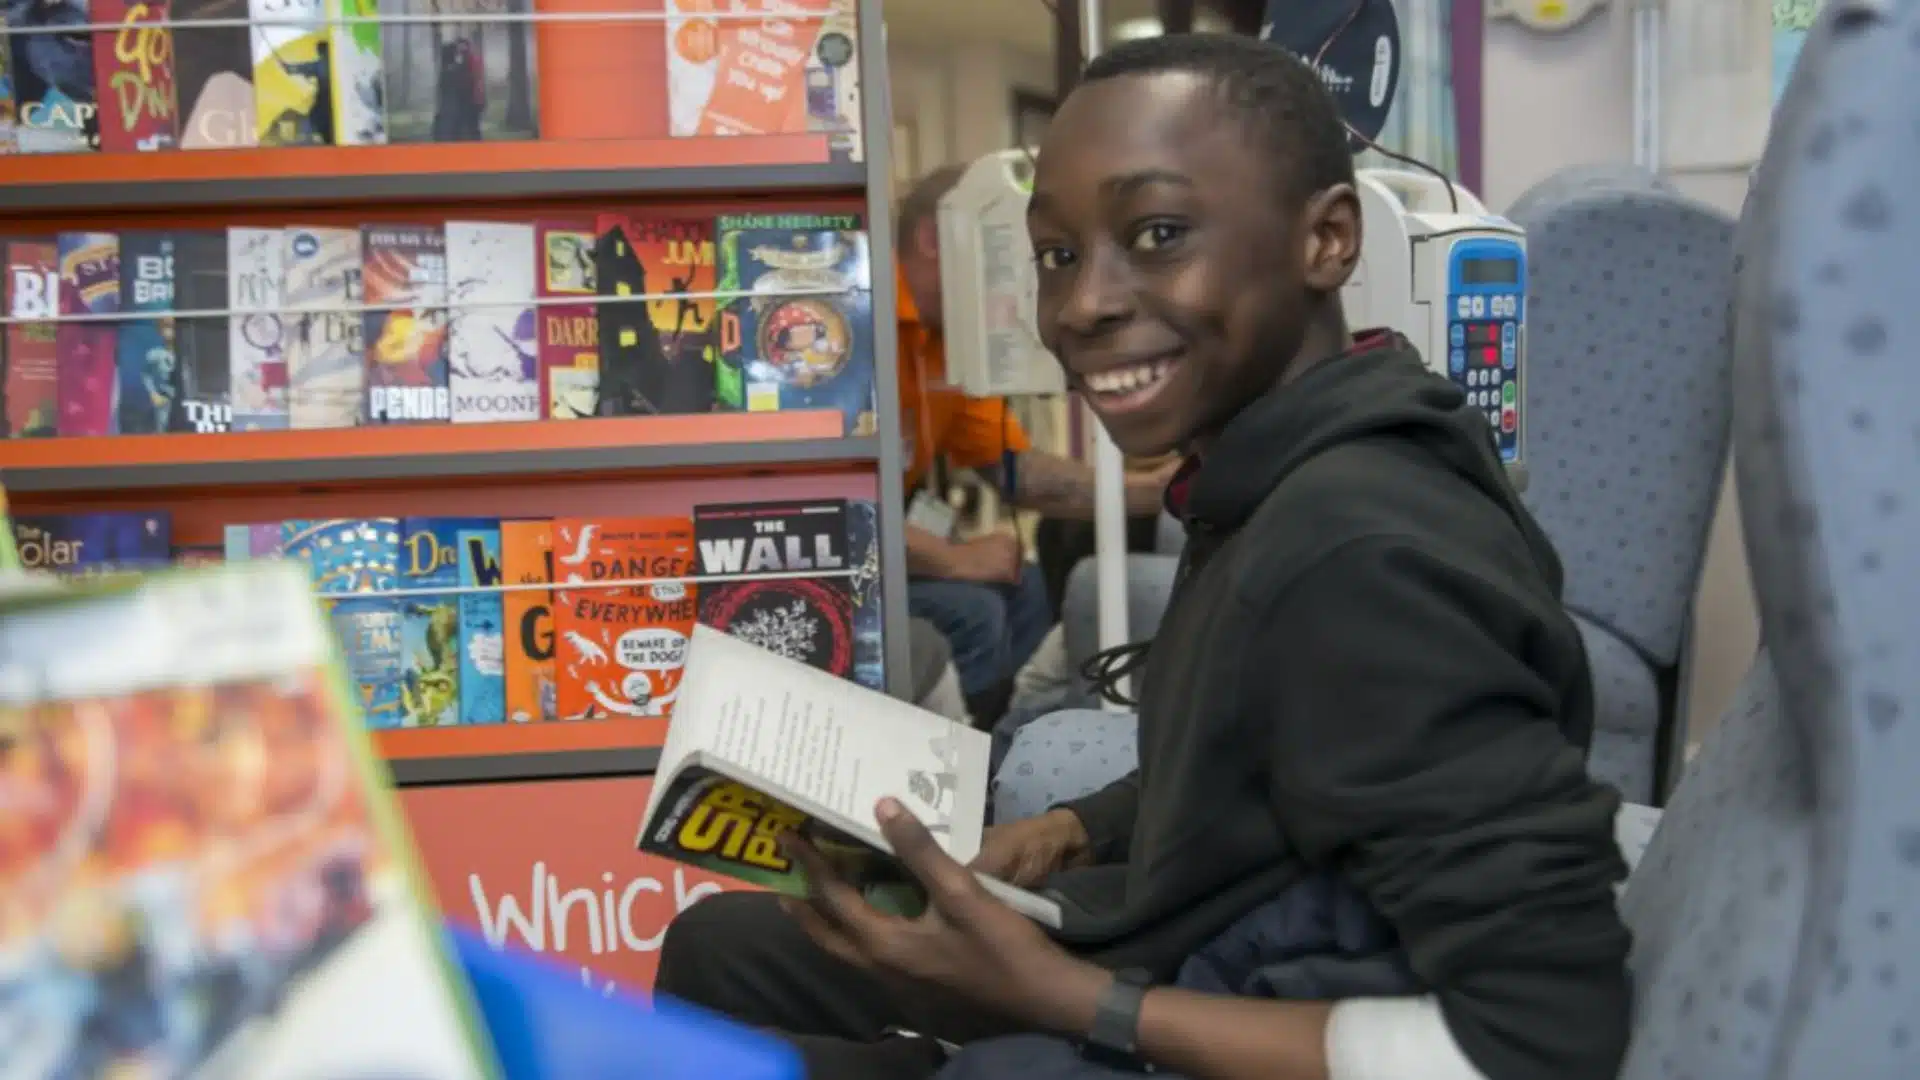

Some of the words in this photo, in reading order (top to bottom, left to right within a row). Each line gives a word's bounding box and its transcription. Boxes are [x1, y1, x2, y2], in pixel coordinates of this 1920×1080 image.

[21, 103, 97, 129] CAP
[754, 520, 785, 533] THE
[699, 534, 843, 574] WALL
[622, 639, 666, 651] BEWARE
[671, 638, 686, 651] OF
[623, 653, 645, 664] THE
